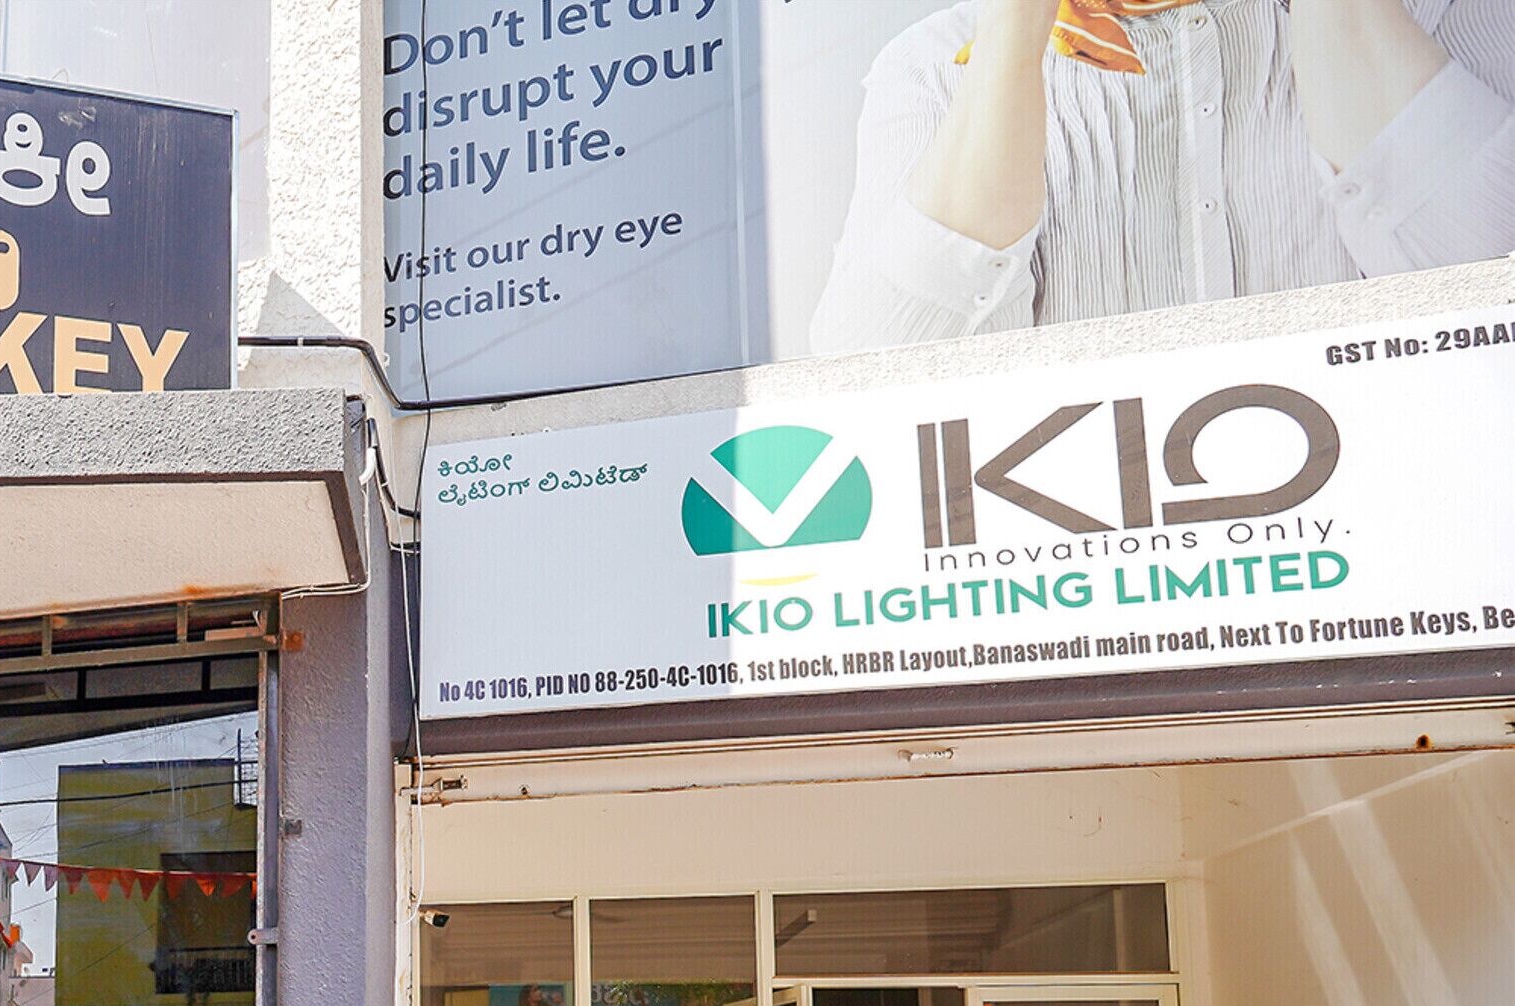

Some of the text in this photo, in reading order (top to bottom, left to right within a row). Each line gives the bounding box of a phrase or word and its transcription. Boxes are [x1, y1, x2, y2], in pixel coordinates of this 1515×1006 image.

[541, 0, 612, 41] let
[383, 37, 724, 138] disrupt your
[383, 120, 627, 200] daily life.
[383, 211, 684, 283] Visit our dry eye
[383, 276, 562, 334] specialist.
[1325, 321, 1515, 366] GST No: 29AA
[923, 516, 1352, 573] Innovations Only.
[706, 549, 1350, 639] IKIO LIGHTING LIMITED
[438, 681, 461, 702] No
[464, 679, 486, 701] 4C
[488, 677, 533, 700] 1016,
[535, 675, 565, 697] PID
[567, 673, 591, 695] NO
[594, 661, 745, 692] 88-250-4C-1016,
[746, 659, 775, 683] 1st
[779, 654, 839, 681] block,
[842, 650, 895, 675] HRBR
[1095, 631, 1152, 657] main
[1156, 626, 1215, 653] road,
[1219, 624, 1272, 648] Next
[1274, 620, 1304, 645] To
[1309, 615, 1405, 643] Fortune
[1409, 610, 1478, 636] Keys,
[1481, 605, 1515, 630] Be
